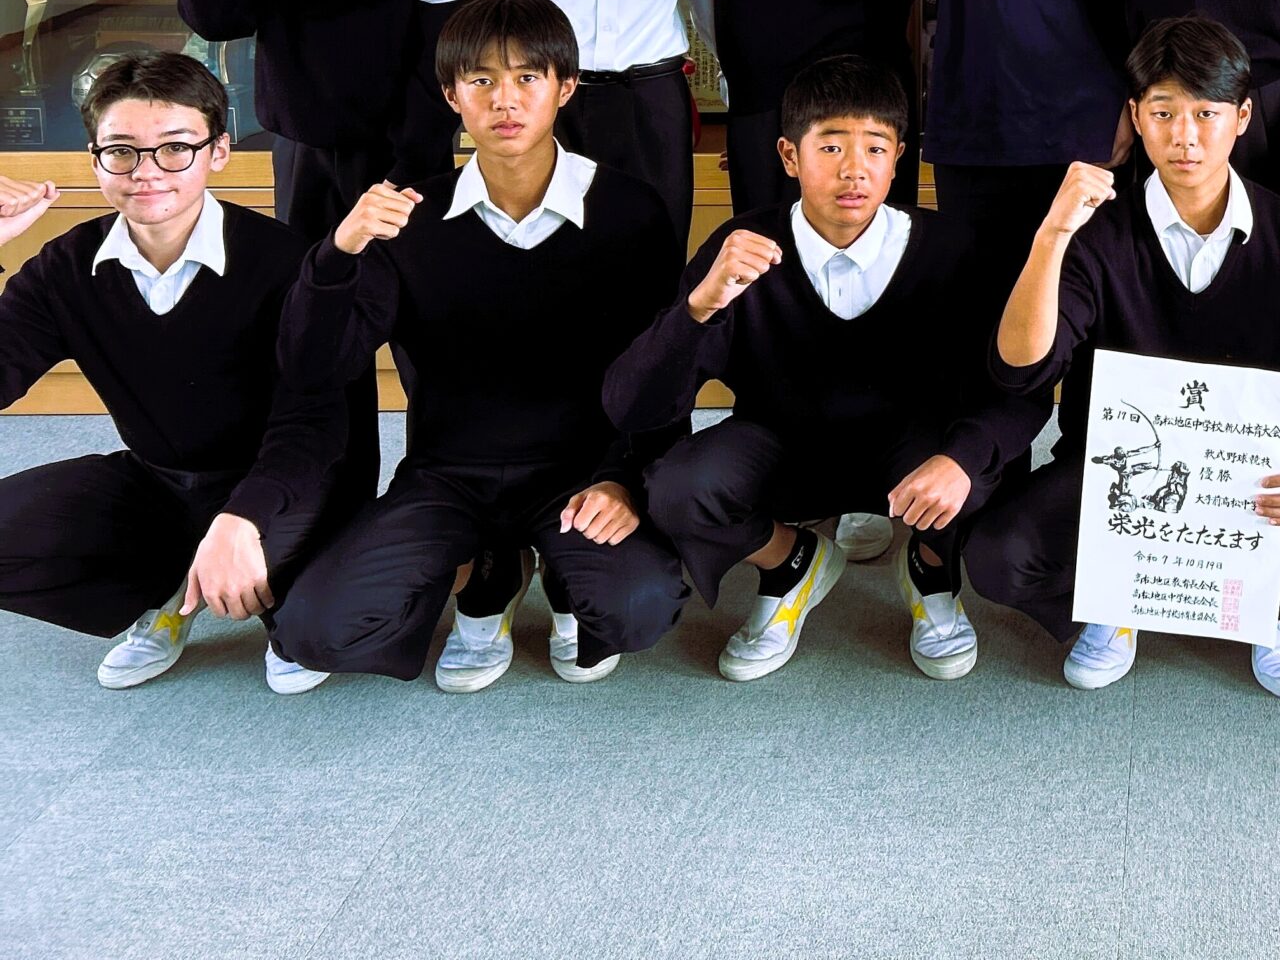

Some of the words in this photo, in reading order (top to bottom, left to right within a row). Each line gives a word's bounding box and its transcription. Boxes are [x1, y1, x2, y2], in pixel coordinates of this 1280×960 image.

[1179, 379, 1210, 412] 賞
[1102, 406, 1141, 424] 第17回
[1204, 448, 1273, 469] 軟式野球競技
[1199, 466, 1233, 482] 優勝
[1108, 513, 1264, 551] 栄光をたたえます
[1133, 550, 1223, 570] 令和7年10月19日
